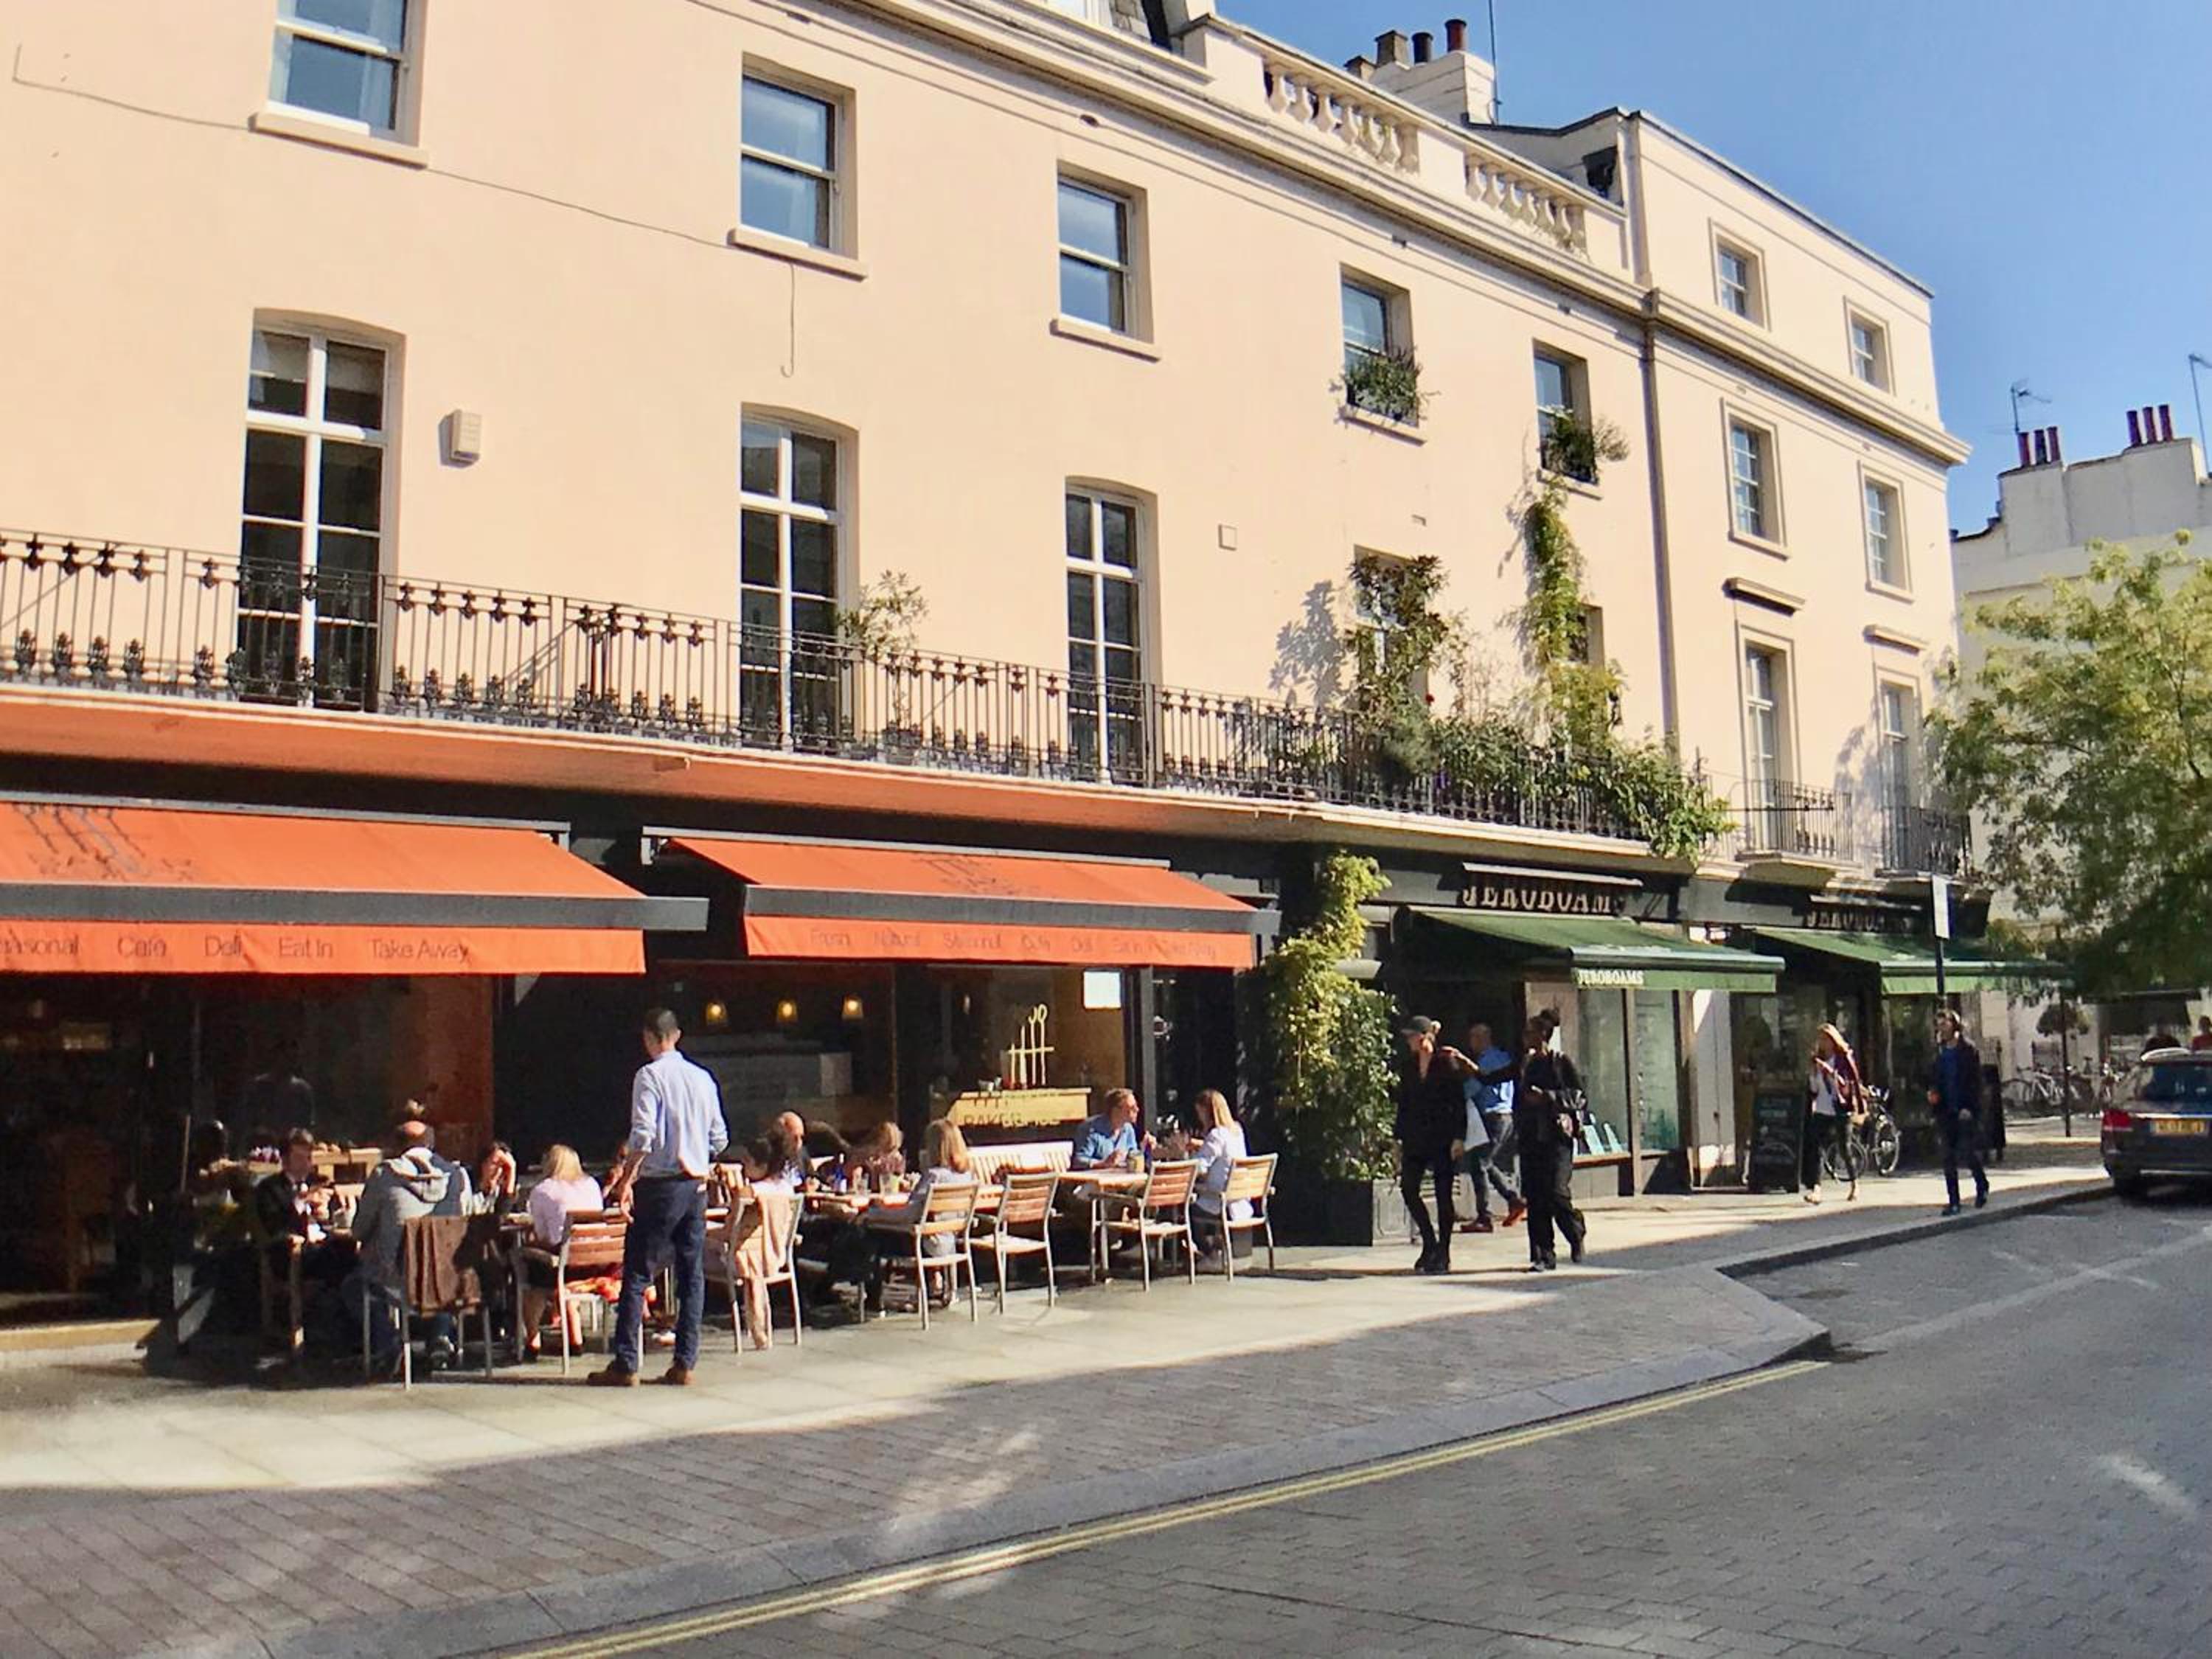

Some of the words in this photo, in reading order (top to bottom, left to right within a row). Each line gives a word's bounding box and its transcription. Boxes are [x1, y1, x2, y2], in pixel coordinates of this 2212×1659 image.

[279, 936, 310, 958] Eat
[316, 938, 333, 959] In
[372, 939, 414, 959] Take
[416, 939, 467, 963] Away
